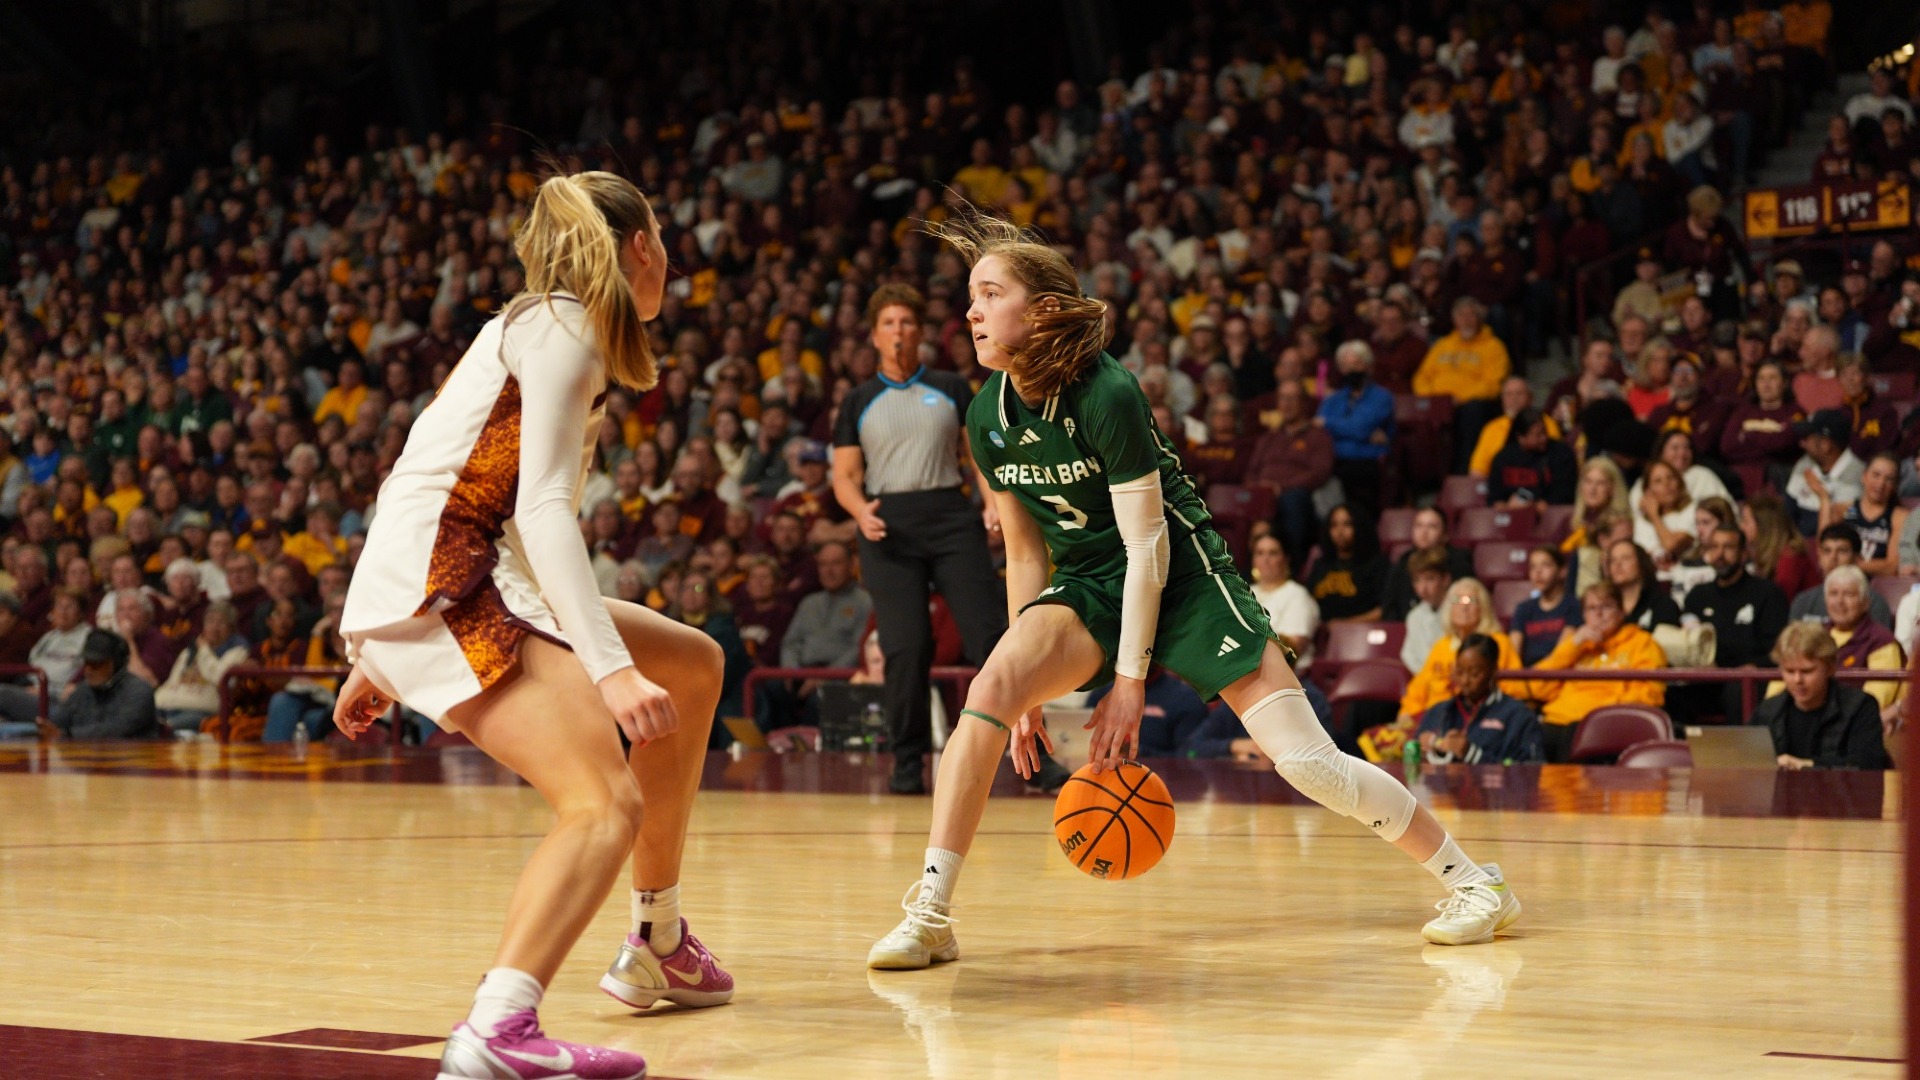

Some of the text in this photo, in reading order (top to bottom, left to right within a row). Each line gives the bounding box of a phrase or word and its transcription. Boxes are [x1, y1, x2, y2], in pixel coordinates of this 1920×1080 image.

[1784, 196, 1818, 224] 116
[994, 456, 1101, 485] GREEN BAY
[1039, 494, 1089, 531] 3
